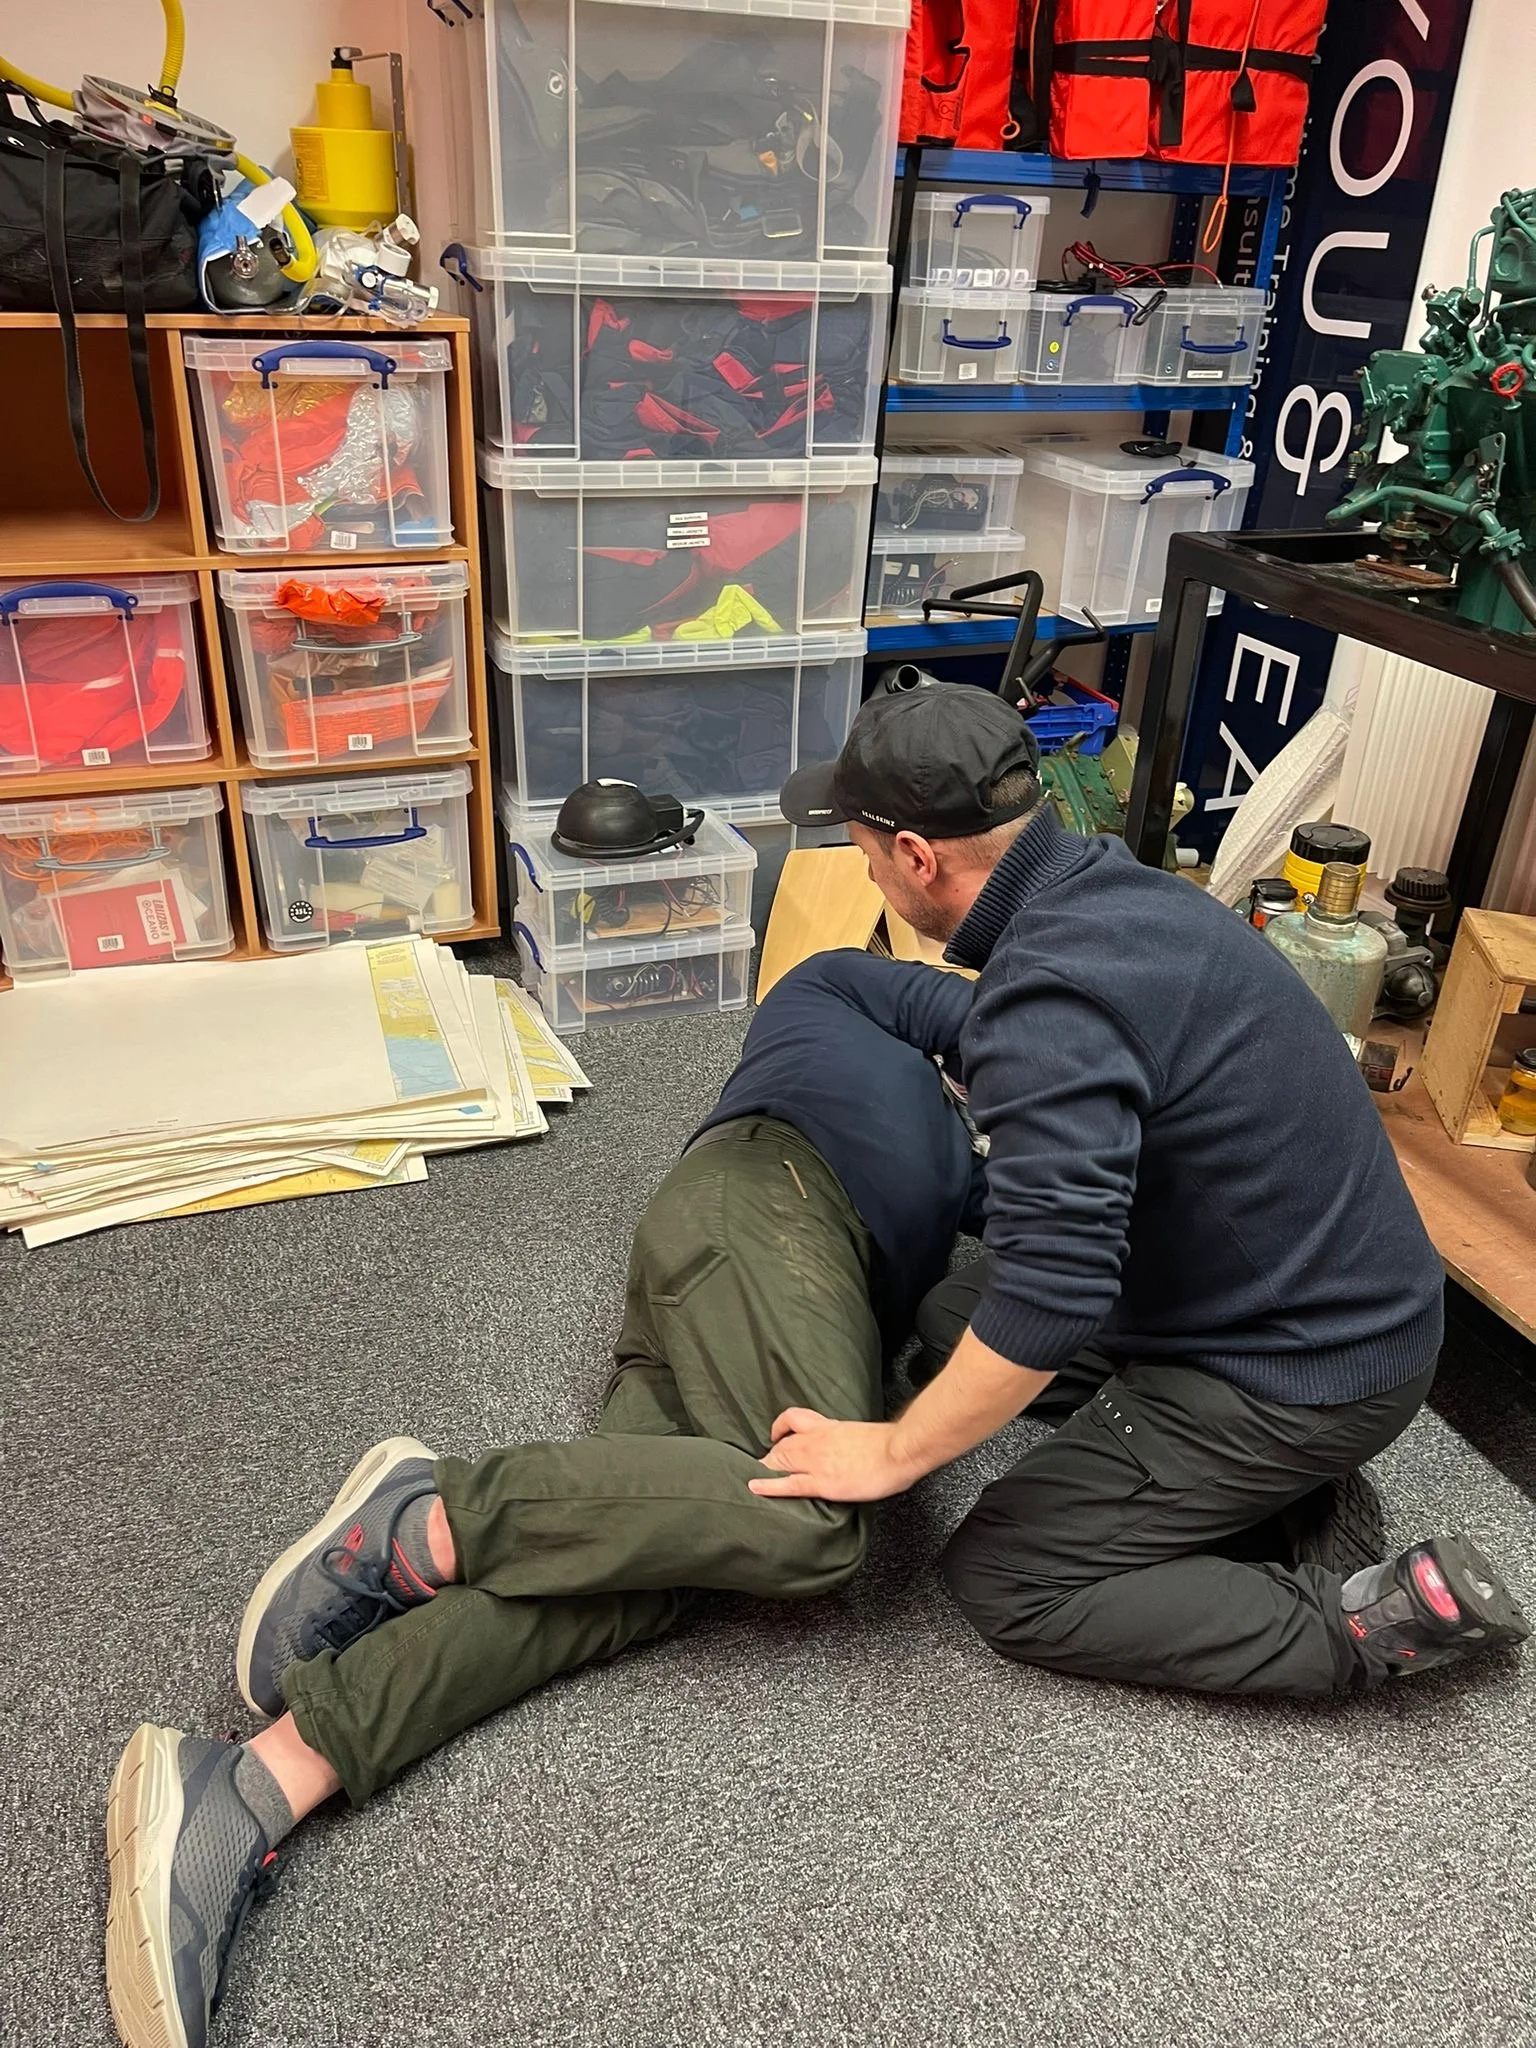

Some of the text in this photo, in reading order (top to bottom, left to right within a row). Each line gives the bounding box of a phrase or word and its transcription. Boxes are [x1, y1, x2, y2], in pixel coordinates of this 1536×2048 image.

[1302, 0, 1432, 340] OU
[1274, 384, 1353, 497] &
[1204, 602, 1301, 812] EA
[142, 899, 161, 940] OCEANO
